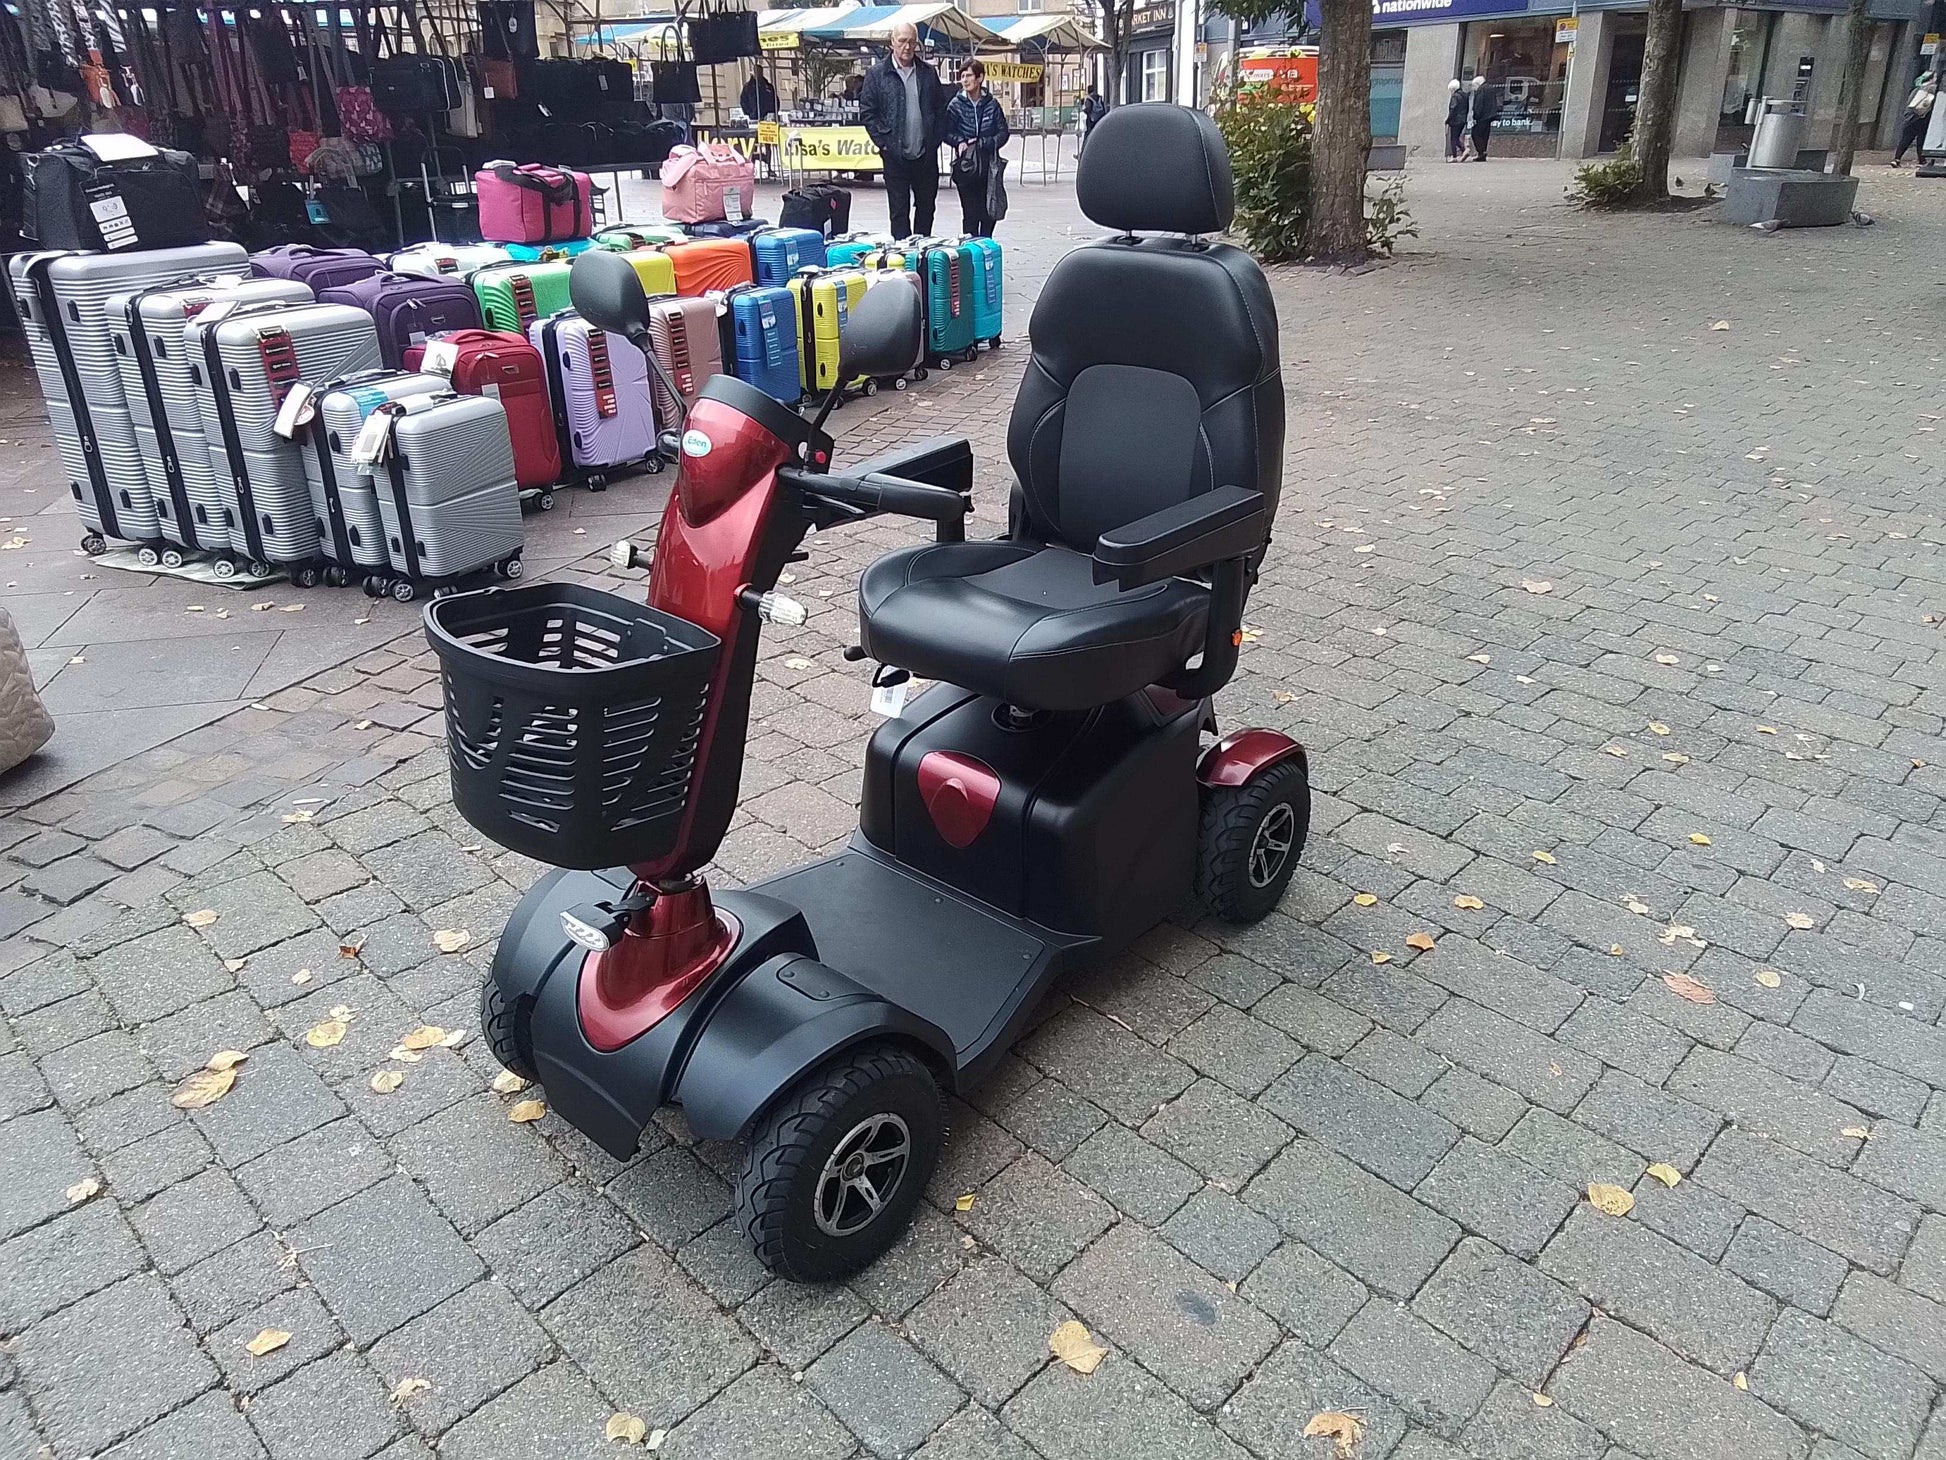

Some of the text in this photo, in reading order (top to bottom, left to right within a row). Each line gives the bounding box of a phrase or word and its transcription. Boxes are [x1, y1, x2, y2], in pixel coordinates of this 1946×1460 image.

[1153, 6, 1167, 22] INN
[1001, 65, 1041, 79] WATCHES
[1502, 118, 1510, 127] to
[687, 435, 707, 448] Eden
